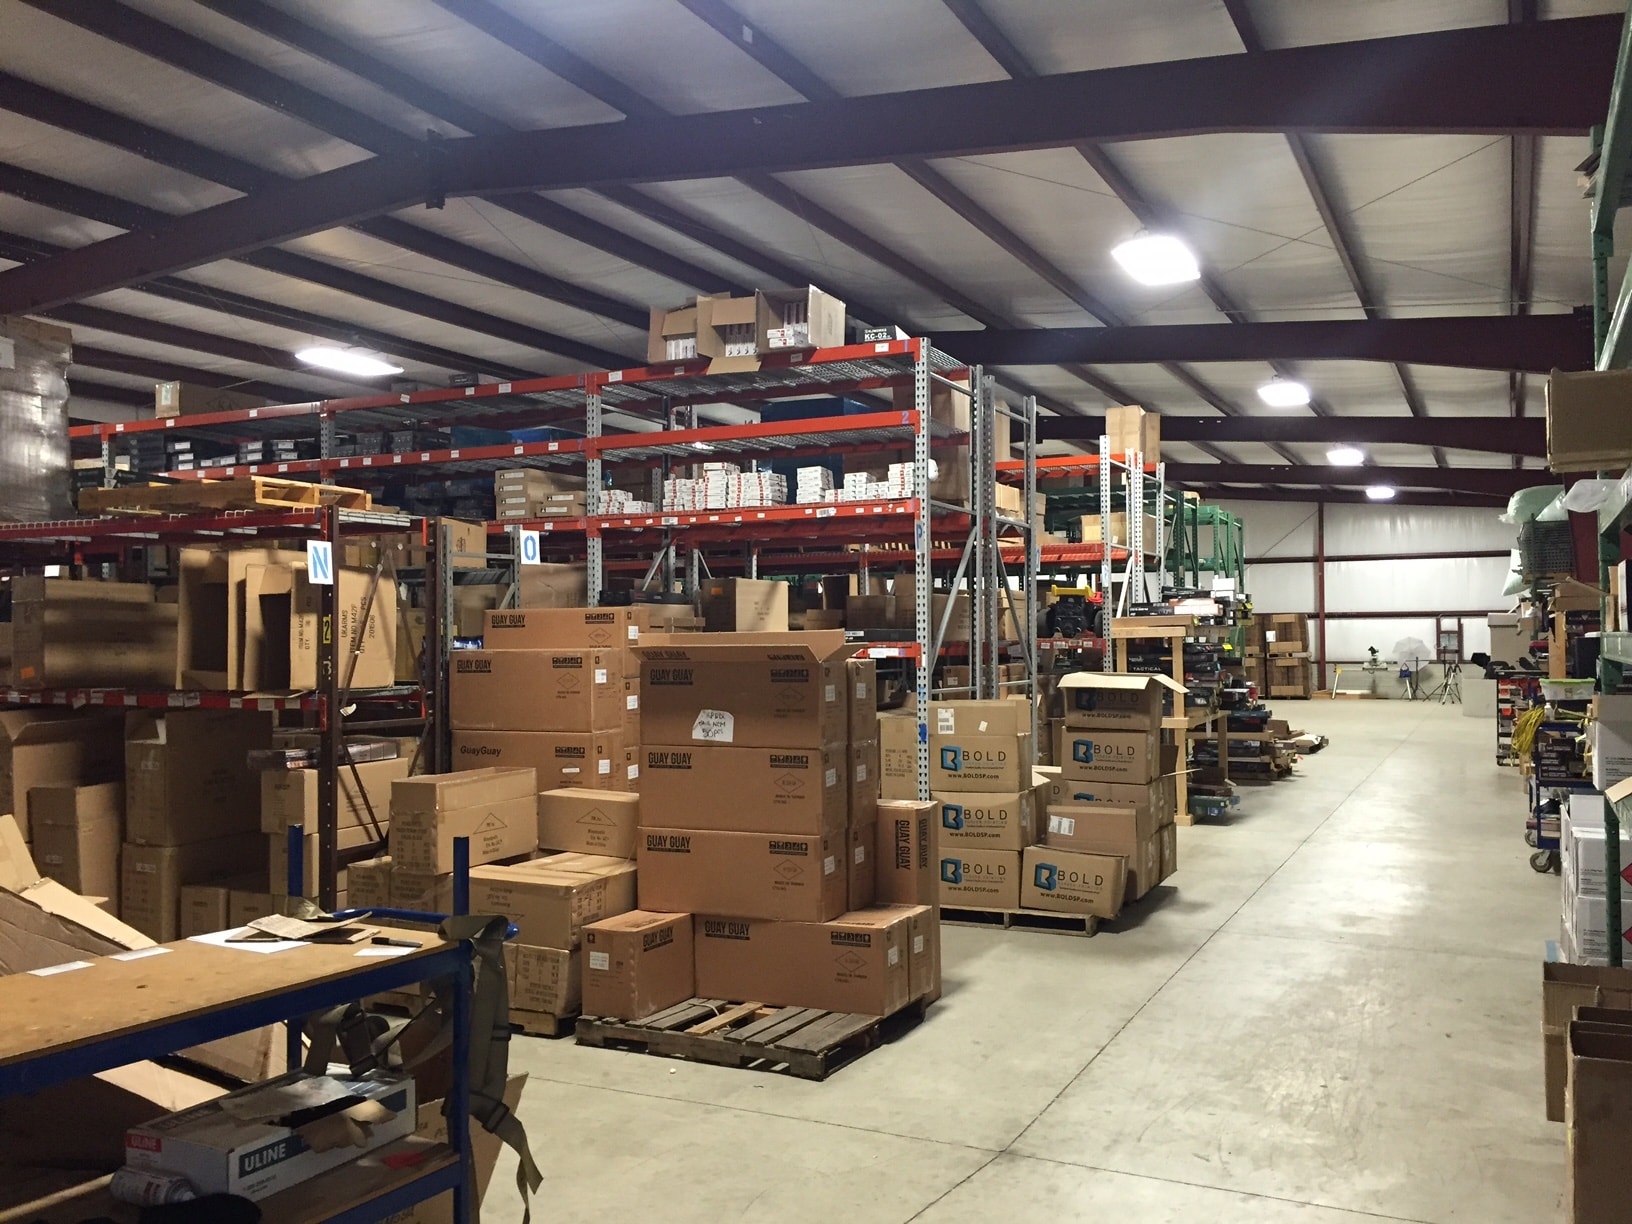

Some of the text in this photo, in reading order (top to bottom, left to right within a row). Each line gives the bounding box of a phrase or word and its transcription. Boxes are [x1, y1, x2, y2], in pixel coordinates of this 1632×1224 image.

[865, 332, 887, 341] KC-02
[902, 410, 909, 424] 2
[312, 545, 329, 579] N
[492, 614, 526, 625] GUAY GUAY
[457, 660, 492, 670] GUAY GUAY
[650, 668, 694, 681] GUAY GUAY
[460, 745, 502, 758] GuayGuay
[962, 750, 1007, 762] BOLD
[1093, 744, 1135, 756] BOLD
[648, 751, 692, 765] GUAY GUAY
[1079, 764, 1128, 772] www.BOLDSP.com
[964, 808, 1008, 820] BOLD
[647, 834, 691, 849] GUAY GUAY
[899, 820, 911, 870] GUAY GUAY
[962, 863, 1007, 876] BOLD
[1057, 870, 1104, 886] BOLD
[947, 885, 1000, 894] www.BOLDSP.com
[1040, 892, 1094, 904] www.BOLDSP.com
[704, 920, 750, 936] GUAY GUAY
[643, 926, 674, 947] GUAY GUAY
[131, 1136, 157, 1150] ULINE
[244, 1143, 287, 1171] ULINE
